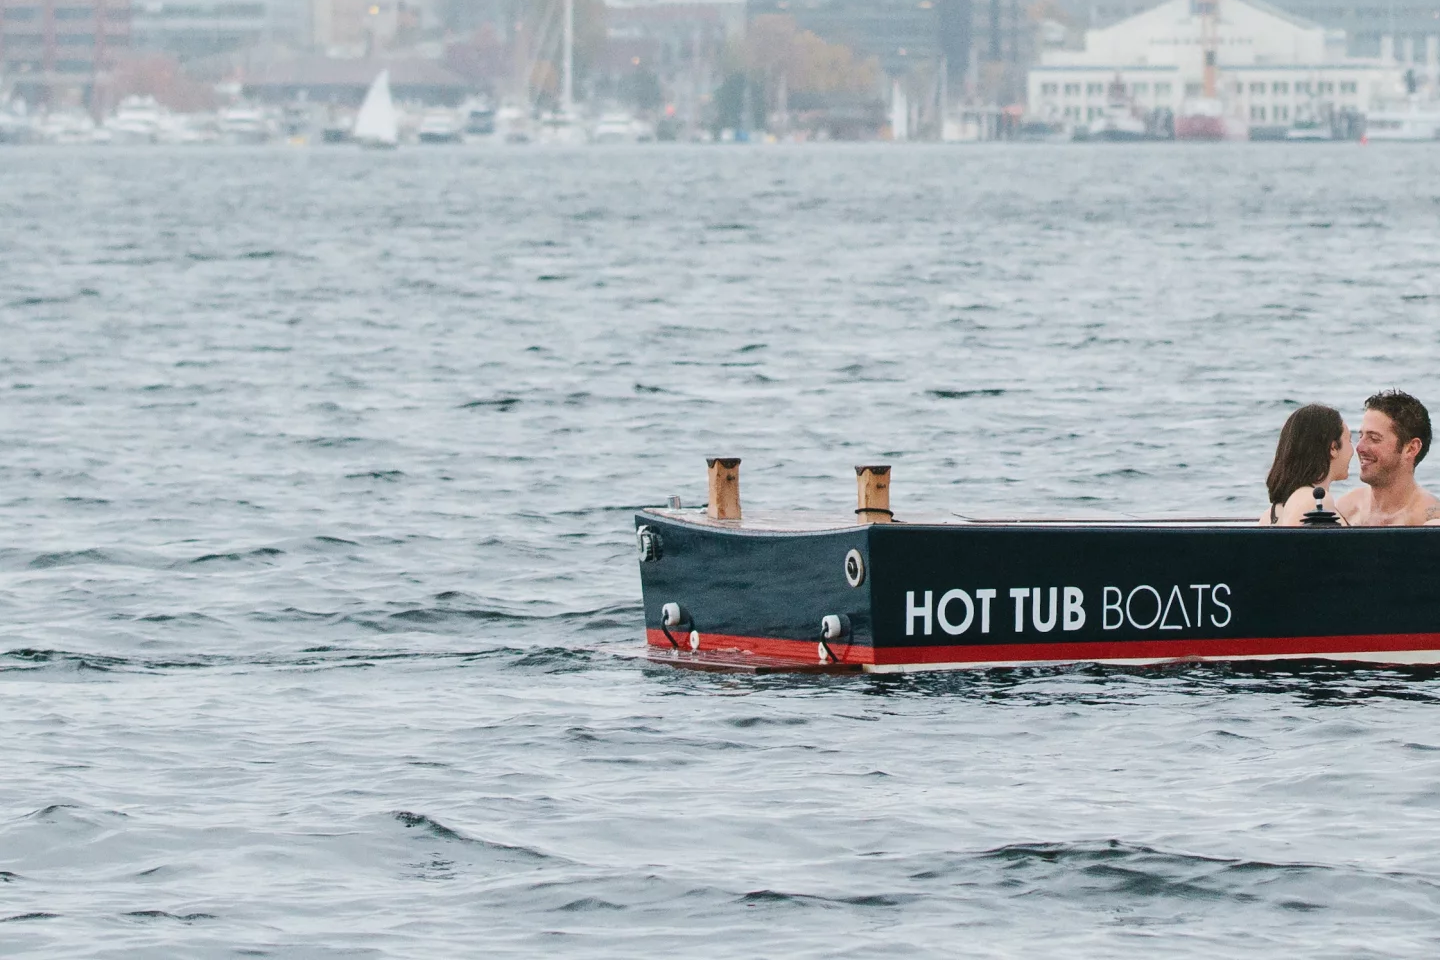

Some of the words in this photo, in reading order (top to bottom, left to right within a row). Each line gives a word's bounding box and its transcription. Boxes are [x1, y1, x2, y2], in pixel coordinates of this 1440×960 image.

[905, 588, 997, 636] HOT
[1009, 586, 1086, 633] TUB
[1102, 583, 1232, 630] BOATS
